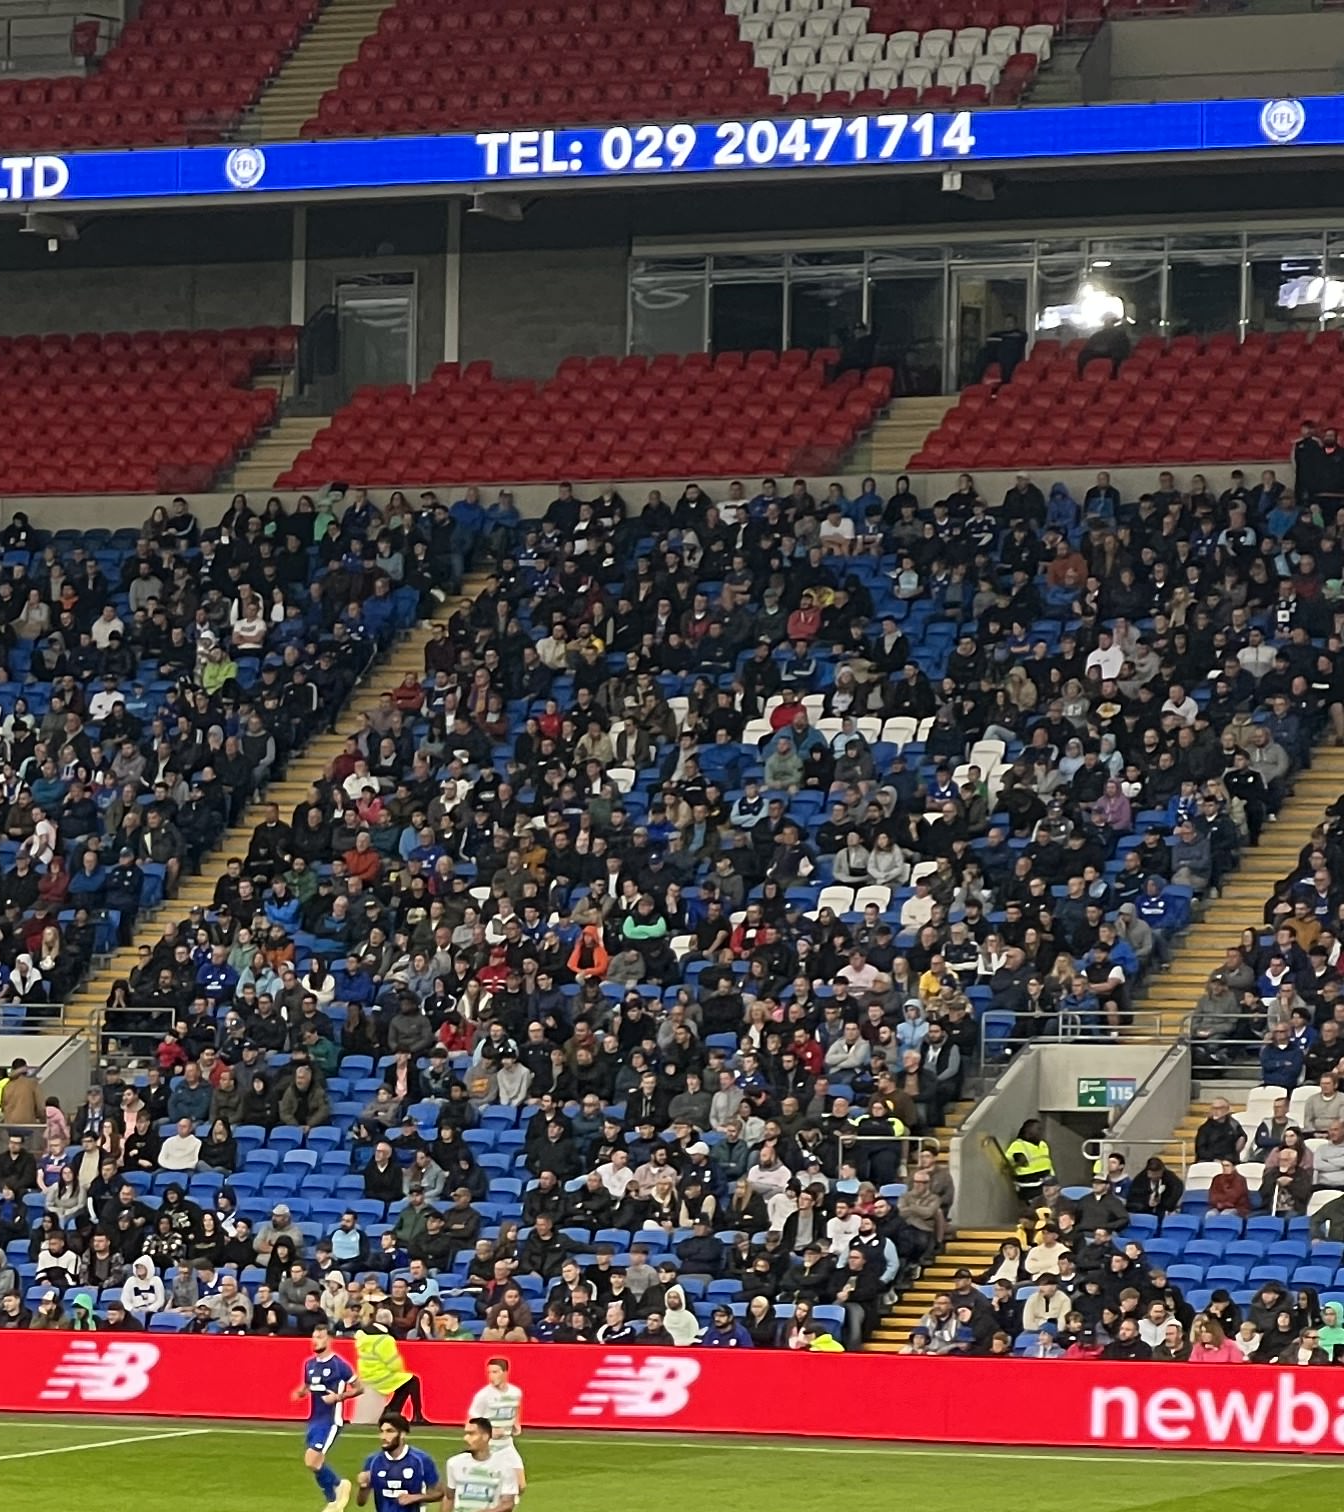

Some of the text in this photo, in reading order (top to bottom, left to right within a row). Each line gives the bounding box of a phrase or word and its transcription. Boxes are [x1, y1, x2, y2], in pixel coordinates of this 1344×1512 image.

[476, 112, 975, 175] TEL: 029 20471714
